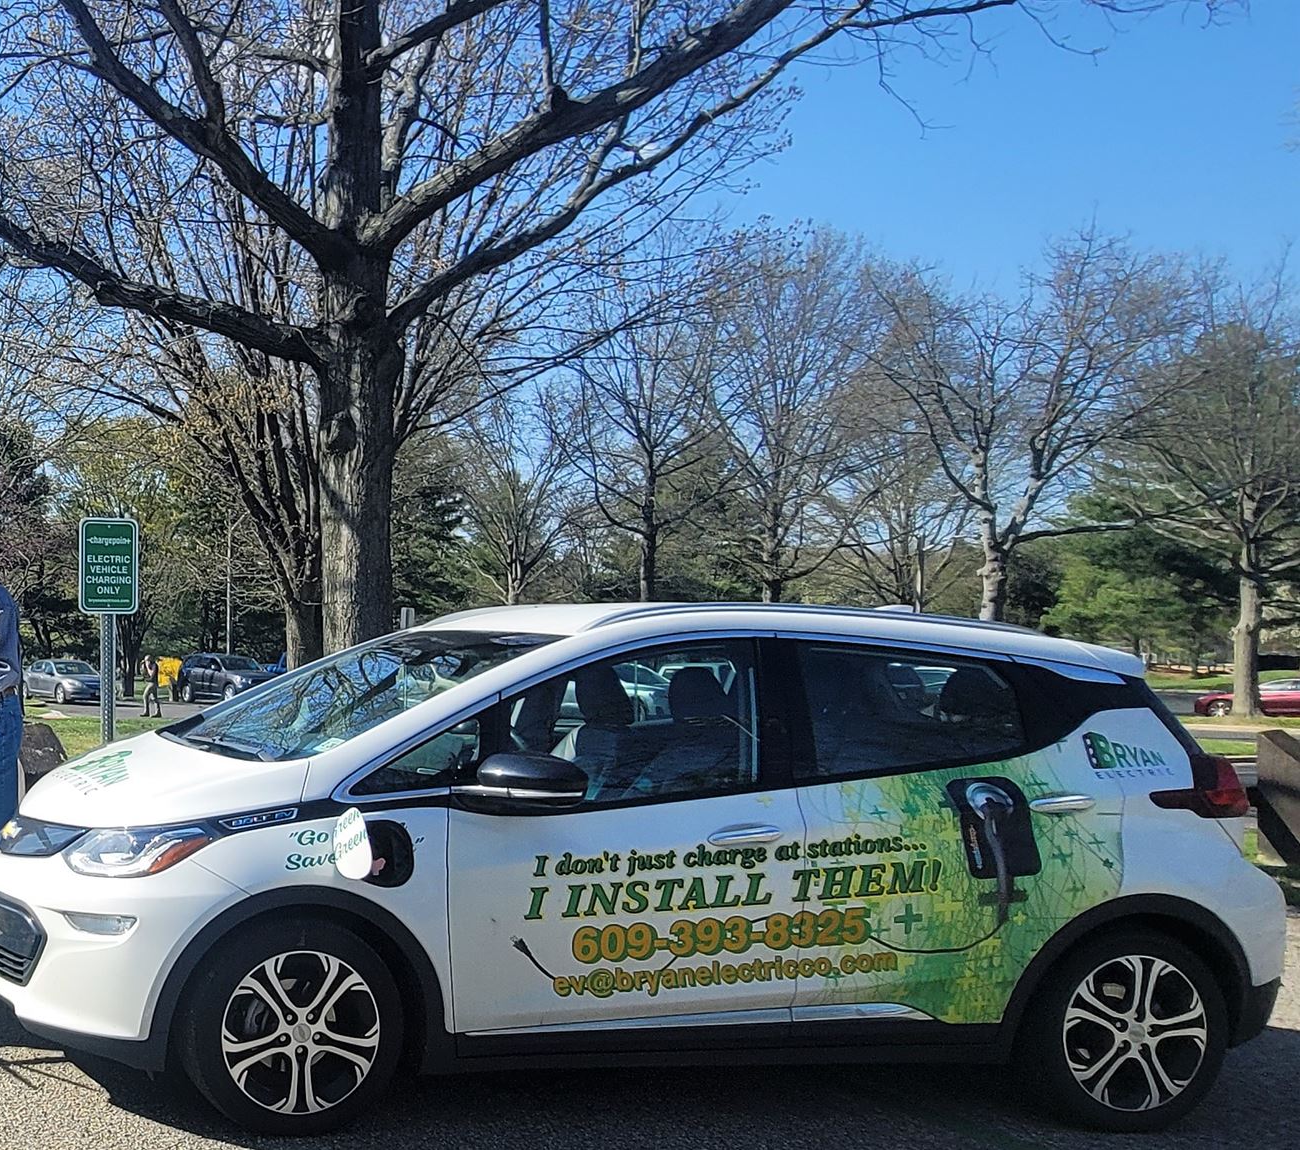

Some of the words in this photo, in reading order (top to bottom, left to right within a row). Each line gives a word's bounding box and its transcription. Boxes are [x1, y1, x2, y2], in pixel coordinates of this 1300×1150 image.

[87, 555, 131, 563] ELECTRIC
[90, 565, 128, 574] VEHICLE
[85, 575, 132, 584] CHARGING
[97, 586, 120, 594] ONLY
[1082, 732, 1166, 769] BRYAN
[1094, 768, 1175, 779] ELECTRIC
[285, 853, 335, 870] Save
[533, 855, 549, 876] I
[555, 851, 621, 876] don't
[626, 850, 677, 876] just
[683, 843, 767, 869] charge
[774, 841, 800, 861] at
[806, 833, 927, 859] stations...
[524, 887, 549, 919] I
[561, 872, 772, 918] INSTALL
[791, 858, 942, 902] THEM!
[572, 907, 872, 964] 609-393-8325
[552, 950, 899, 998] ev@bryanelectricco.com
